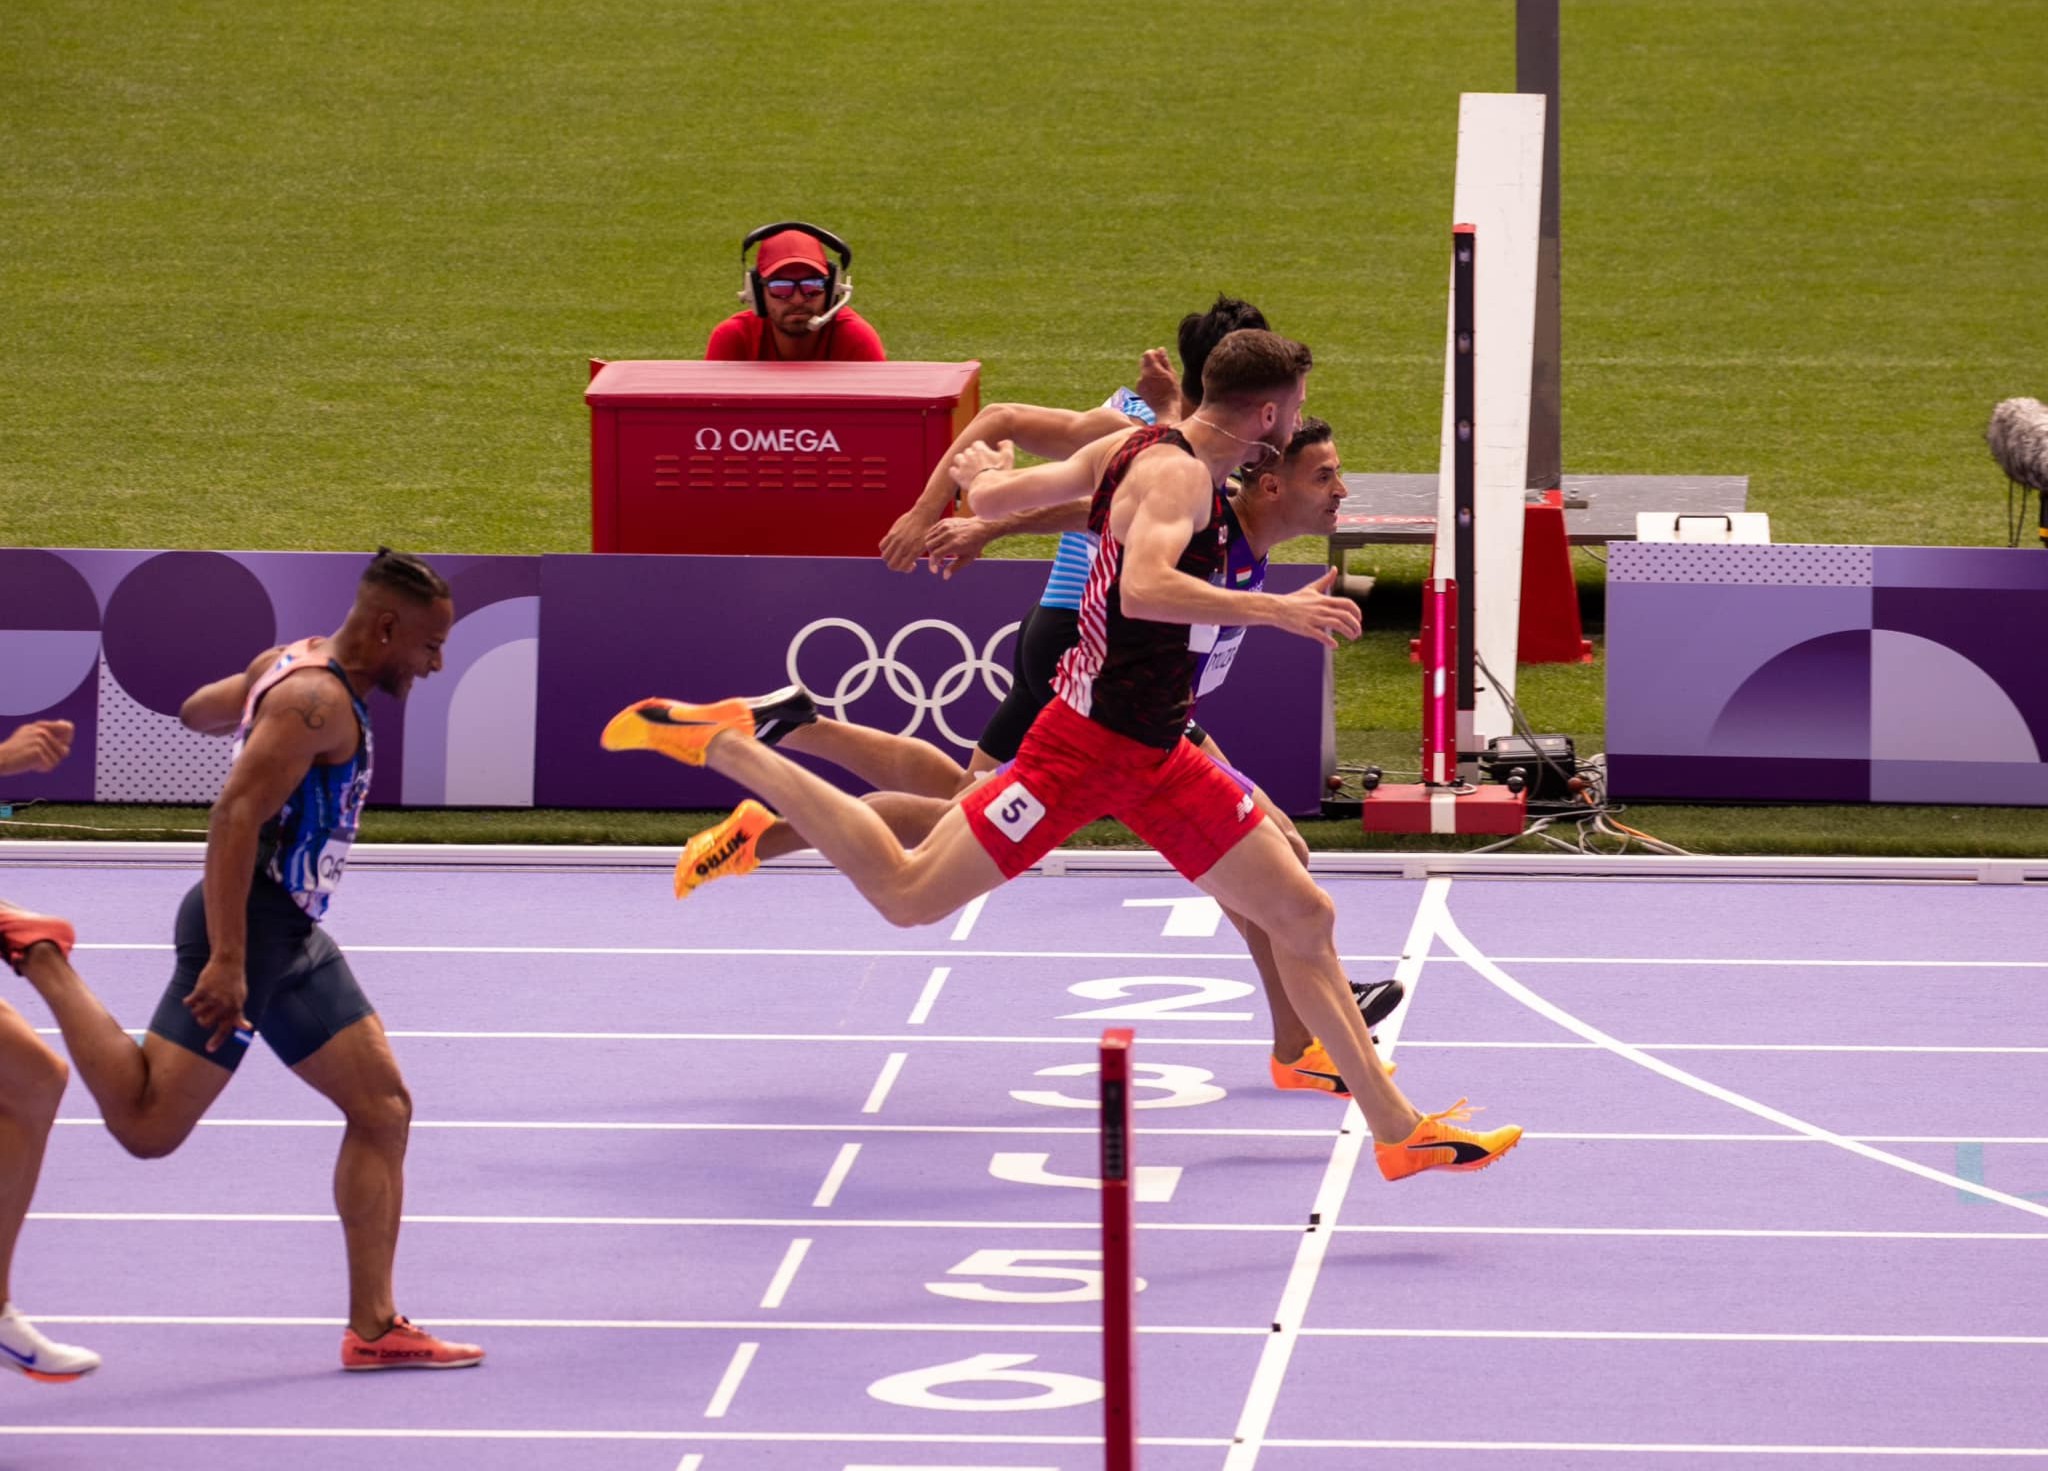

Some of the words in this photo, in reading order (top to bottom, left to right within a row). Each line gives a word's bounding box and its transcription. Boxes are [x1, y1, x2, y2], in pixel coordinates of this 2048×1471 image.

[729, 428, 842, 453] OMEGA
[1001, 796, 1029, 825] 5
[1121, 895, 1224, 937] 1
[1052, 975, 1256, 1021] 2
[1008, 1062, 1227, 1109] 3
[923, 1248, 1148, 1304] 5
[865, 1352, 1106, 1412] 6
